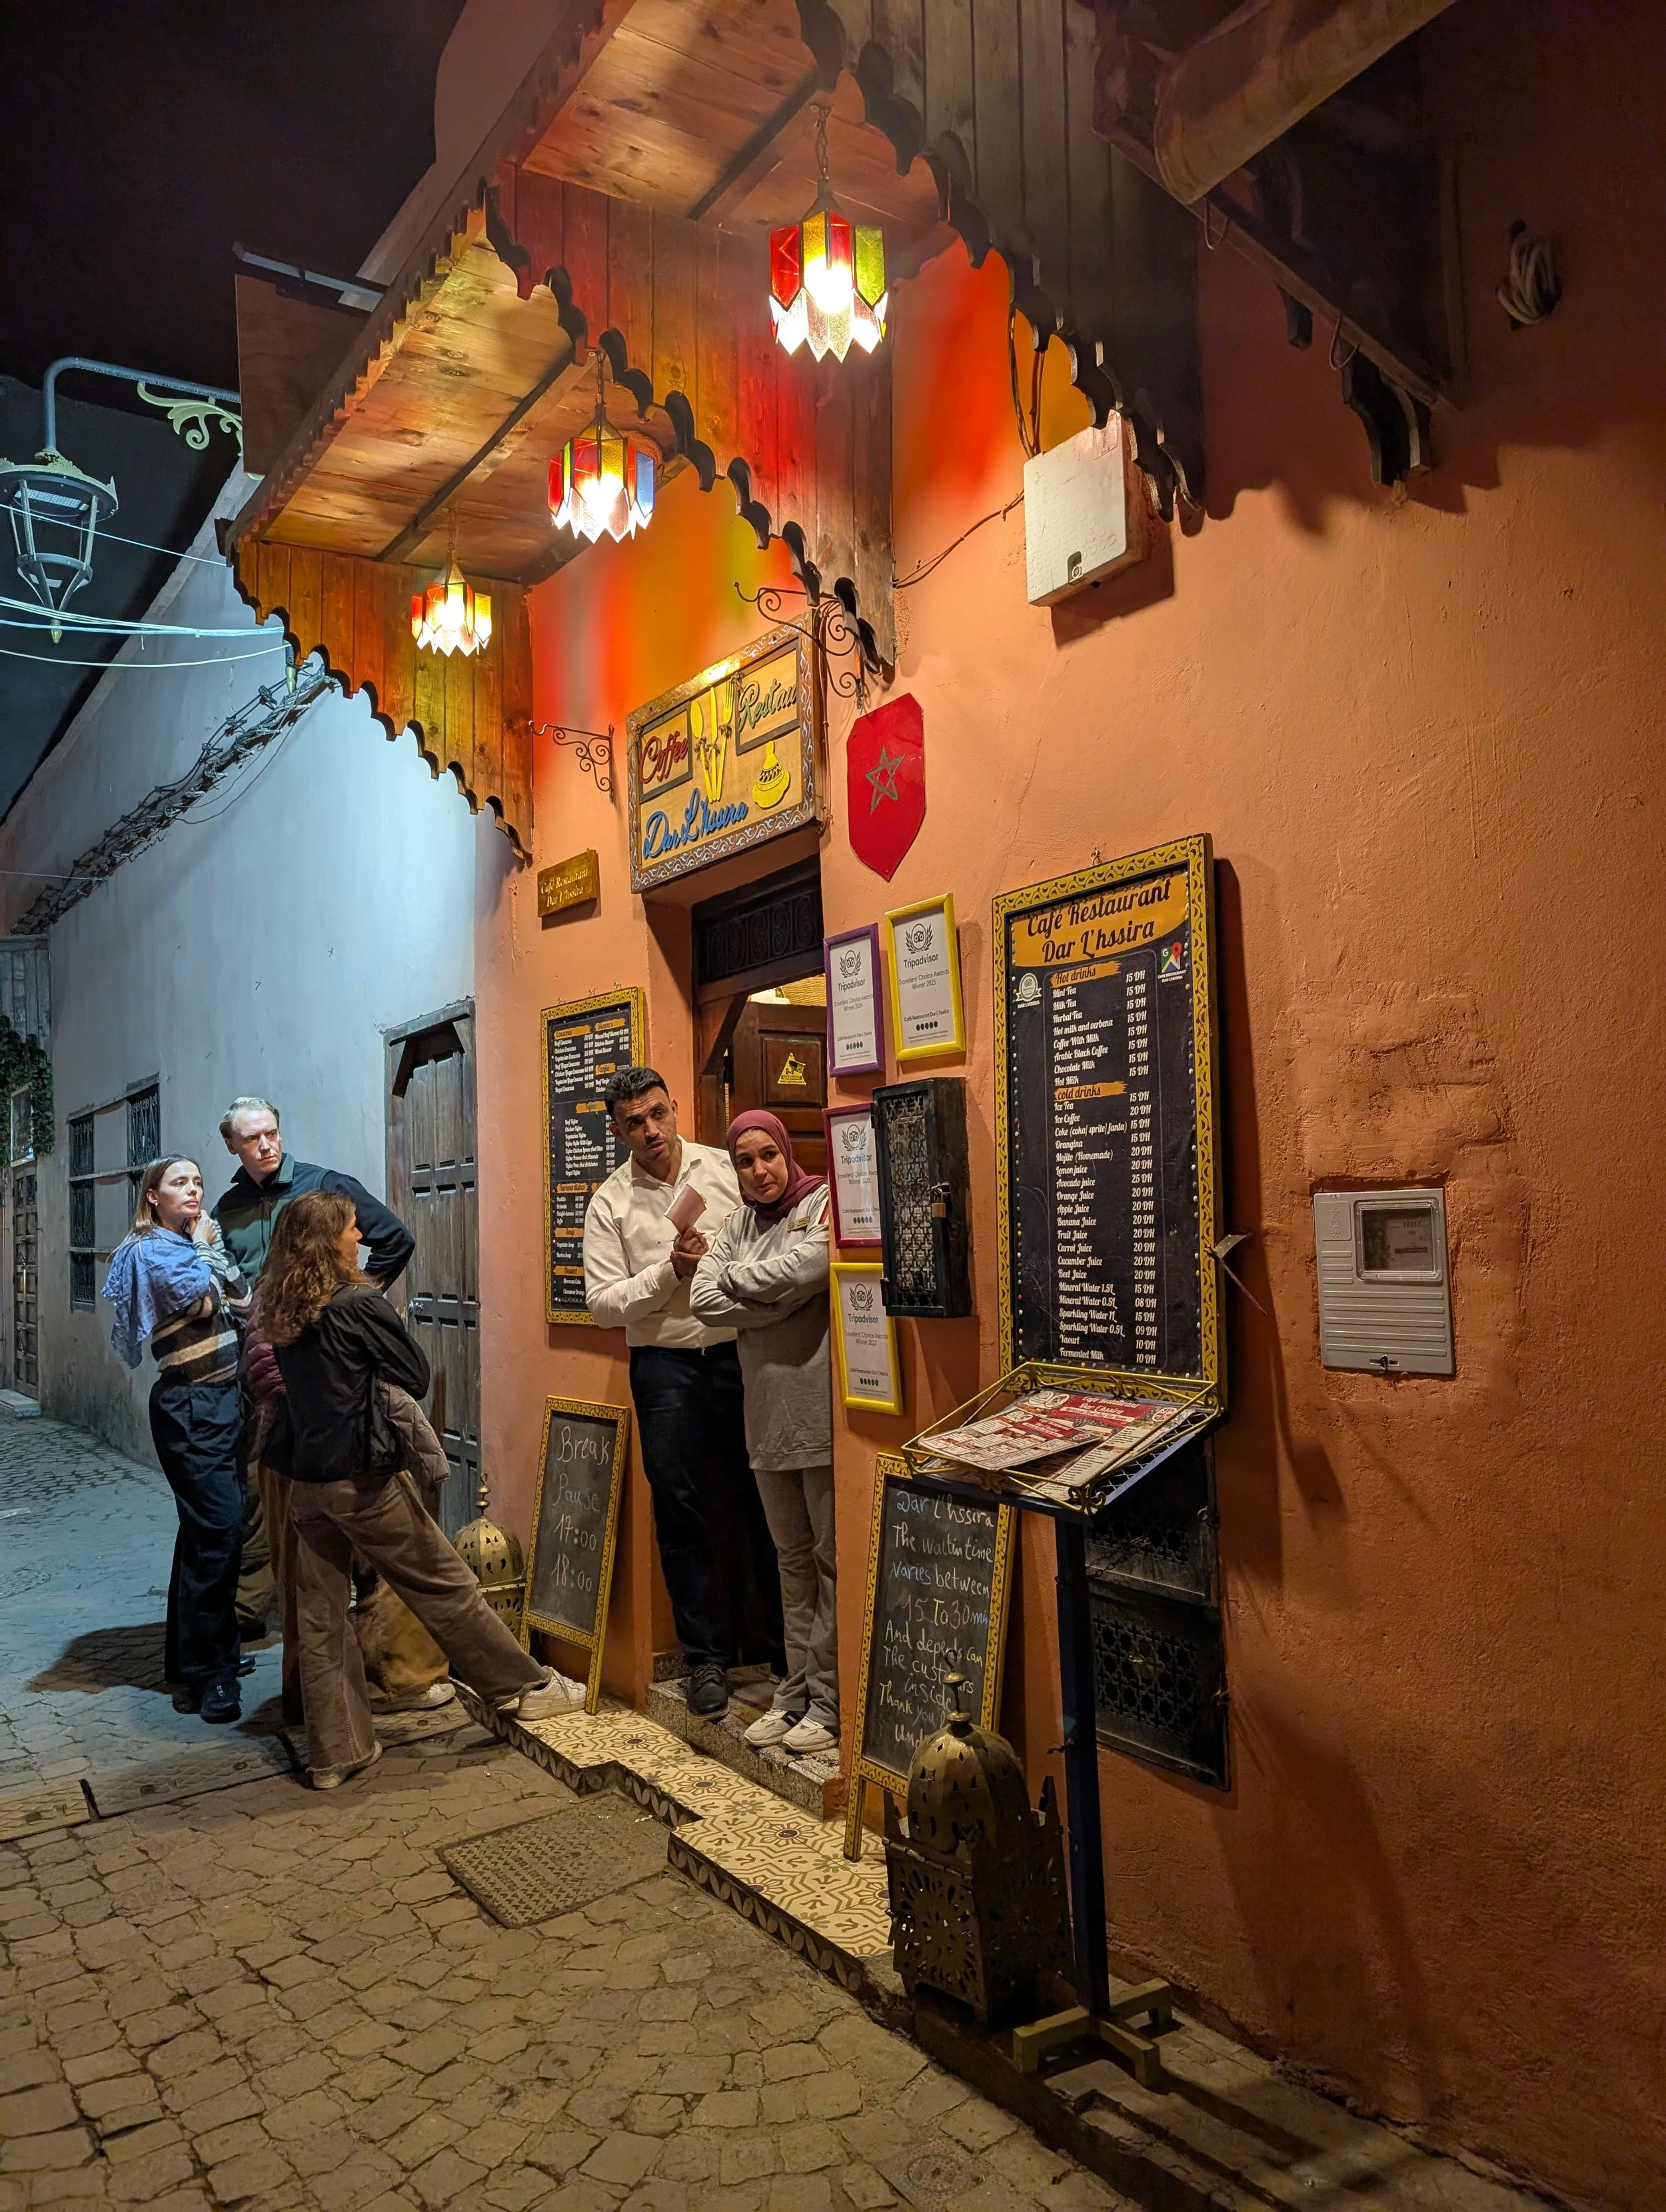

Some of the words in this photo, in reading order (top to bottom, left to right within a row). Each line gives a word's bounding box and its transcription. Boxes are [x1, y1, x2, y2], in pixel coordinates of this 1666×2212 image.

[640, 730, 688, 783] Coffee
[643, 810, 680, 860] Dar
[1027, 905, 1062, 939] Café
[1069, 878, 1172, 926] Restaurant
[1042, 940, 1076, 963] Dar
[1080, 920, 1154, 959] L'hssira
[904, 953, 938, 969] Tripadvisor
[1056, 972, 1069, 984] Hot
[1071, 967, 1096, 979] drinks
[838, 979, 866, 992] Tripadvisor
[1052, 988, 1065, 998] Mint
[1066, 987, 1076, 995] Tea
[1126, 973, 1133, 983] 15
[1134, 970, 1146, 981] DH
[1053, 1001, 1065, 1011] Milk
[1066, 999, 1076, 1008] Tea
[1126, 987, 1133, 996] 15
[1134, 983, 1146, 994] DH
[1053, 1013, 1071, 1023] Herbal
[1072, 1011, 1082, 1019] Tea
[1127, 1000, 1134, 1009] 15
[1135, 997, 1146, 1007] DH
[1054, 1027, 1064, 1036] Hot
[1064, 1025, 1077, 1034] milk
[1090, 1019, 1113, 1030] verbena
[1128, 1014, 1134, 1023] 15
[1135, 1011, 1146, 1021] DH
[1054, 1038, 1069, 1050] Coffee
[1070, 1036, 1085, 1046] With
[1086, 1033, 1099, 1043] Milk
[1054, 1051, 1073, 1062] Arabic
[1074, 1049, 1090, 1058] Black
[1092, 1045, 1108, 1057] Coffee
[1054, 1063, 1080, 1074] Chocolate
[1082, 1061, 1095, 1070] Milk
[1054, 1077, 1064, 1087] Hot
[1066, 1075, 1079, 1085] Milk
[1058, 1088, 1073, 1100] cold
[1076, 1085, 1100, 1097] drinks
[1064, 1101, 1074, 1110] Tea
[1064, 1114, 1080, 1125] Coffee
[1130, 1107, 1140, 1115] 20
[1140, 1105, 1151, 1115] DH
[1055, 1127, 1068, 1137] Coke
[1108, 1122, 1128, 1134] fanta)
[1056, 1140, 1082, 1151] Orangina
[840, 1154, 872, 1165] Tripadvisor
[1056, 1153, 1073, 1164] Mojito
[1076, 1149, 1113, 1163] (Homemade)
[1056, 1166, 1074, 1177] Lemon
[1056, 1179, 1080, 1189] Avocado
[1132, 1175, 1140, 1183] 25
[1142, 1173, 1152, 1183] DH
[1057, 1192, 1078, 1202] Orange
[1079, 1191, 1094, 1202] Juice
[1057, 1205, 1073, 1215] Apple
[1074, 1204, 1089, 1214] Juice
[1057, 1217, 1080, 1227] Banana
[1081, 1217, 1096, 1228] Juice
[1058, 1231, 1071, 1239] Fruit
[1072, 1231, 1088, 1241] Juice
[1058, 1243, 1076, 1252] Carrot
[1077, 1243, 1092, 1254] Juice
[1058, 1256, 1086, 1265] Cucumber
[1087, 1257, 1102, 1267] Juice
[1058, 1269, 1070, 1278] Beet
[1072, 1270, 1087, 1280] Juice
[1059, 1282, 1081, 1292] Mineral
[1082, 1283, 1100, 1293] Water
[1102, 1284, 1116, 1295] 1.5L
[1059, 1295, 1081, 1305] Mineral
[1082, 1297, 1101, 1306] Water
[1102, 1297, 1118, 1309] 0.5L
[1135, 1299, 1144, 1308] 08
[1146, 1298, 1157, 1308] DH
[848, 1314, 879, 1324] Tripadvisor
[1059, 1309, 1088, 1321] Sparkling
[1089, 1310, 1108, 1320] Water
[1059, 1322, 1088, 1335] Sparkling
[1090, 1323, 1108, 1333] Water
[1110, 1325, 1126, 1337] 0.5L
[1060, 1335, 1080, 1345] Yaourt
[1060, 1347, 1090, 1359] Fermented
[1090, 1351, 1104, 1360] Milk
[557, 1426, 610, 1465] Break
[552, 1473, 600, 1512] Pause
[896, 1491, 929, 1513] Dar
[553, 1513, 596, 1551] 17:00
[892, 1522, 916, 1552] The
[965, 1537, 993, 1562] time
[550, 1554, 592, 1592] 18:00
[935, 1563, 990, 1598] between
[902, 1594, 934, 1624] 15
[934, 1598, 948, 1626] To
[950, 1600, 970, 1629] 30
[885, 1620, 912, 1649] And
[883, 1646, 908, 1670] The
[880, 1680, 913, 1714] Thank
[905, 1673, 952, 1712] inside
